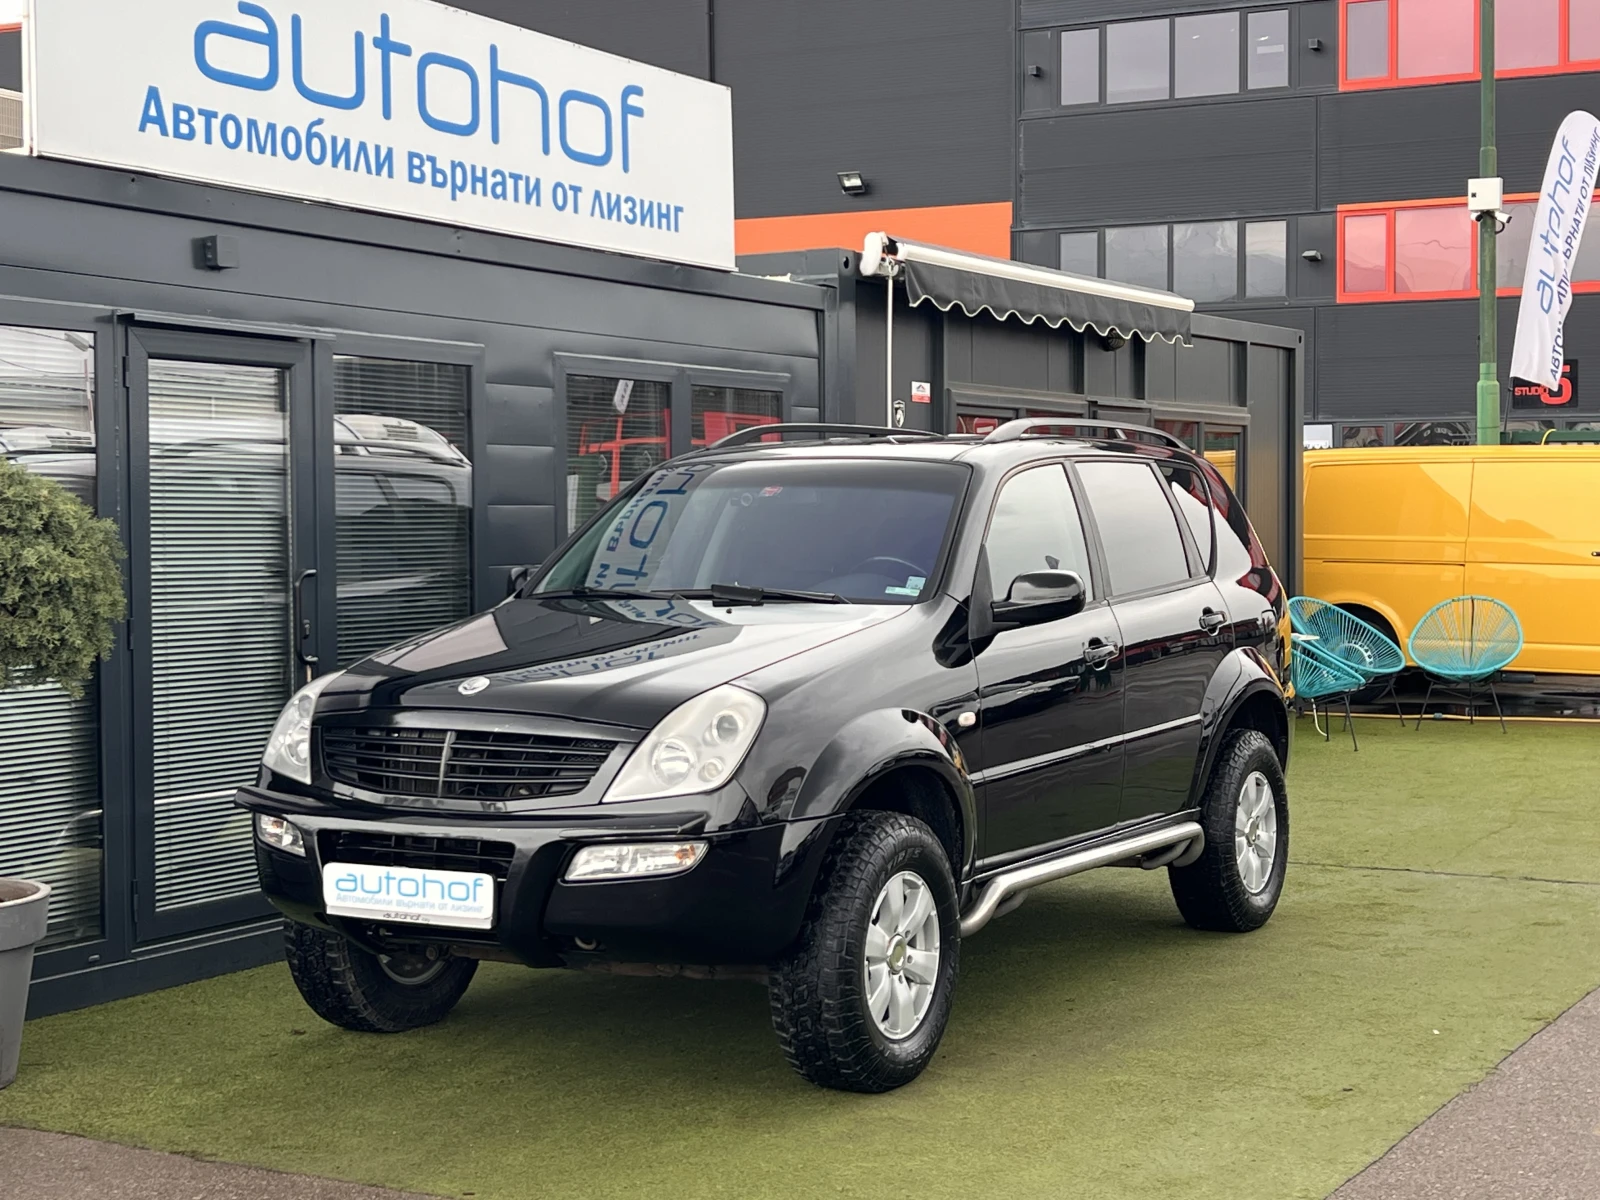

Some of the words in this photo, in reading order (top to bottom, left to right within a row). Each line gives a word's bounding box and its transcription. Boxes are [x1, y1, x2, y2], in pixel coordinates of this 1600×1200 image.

[138, 85, 395, 179] Автомобили
[407, 151, 543, 209] върнати
[551, 180, 583, 215] от
[589, 189, 685, 234] лизинг
[193, 1, 645, 174] autohof
[335, 871, 484, 902] autohof
